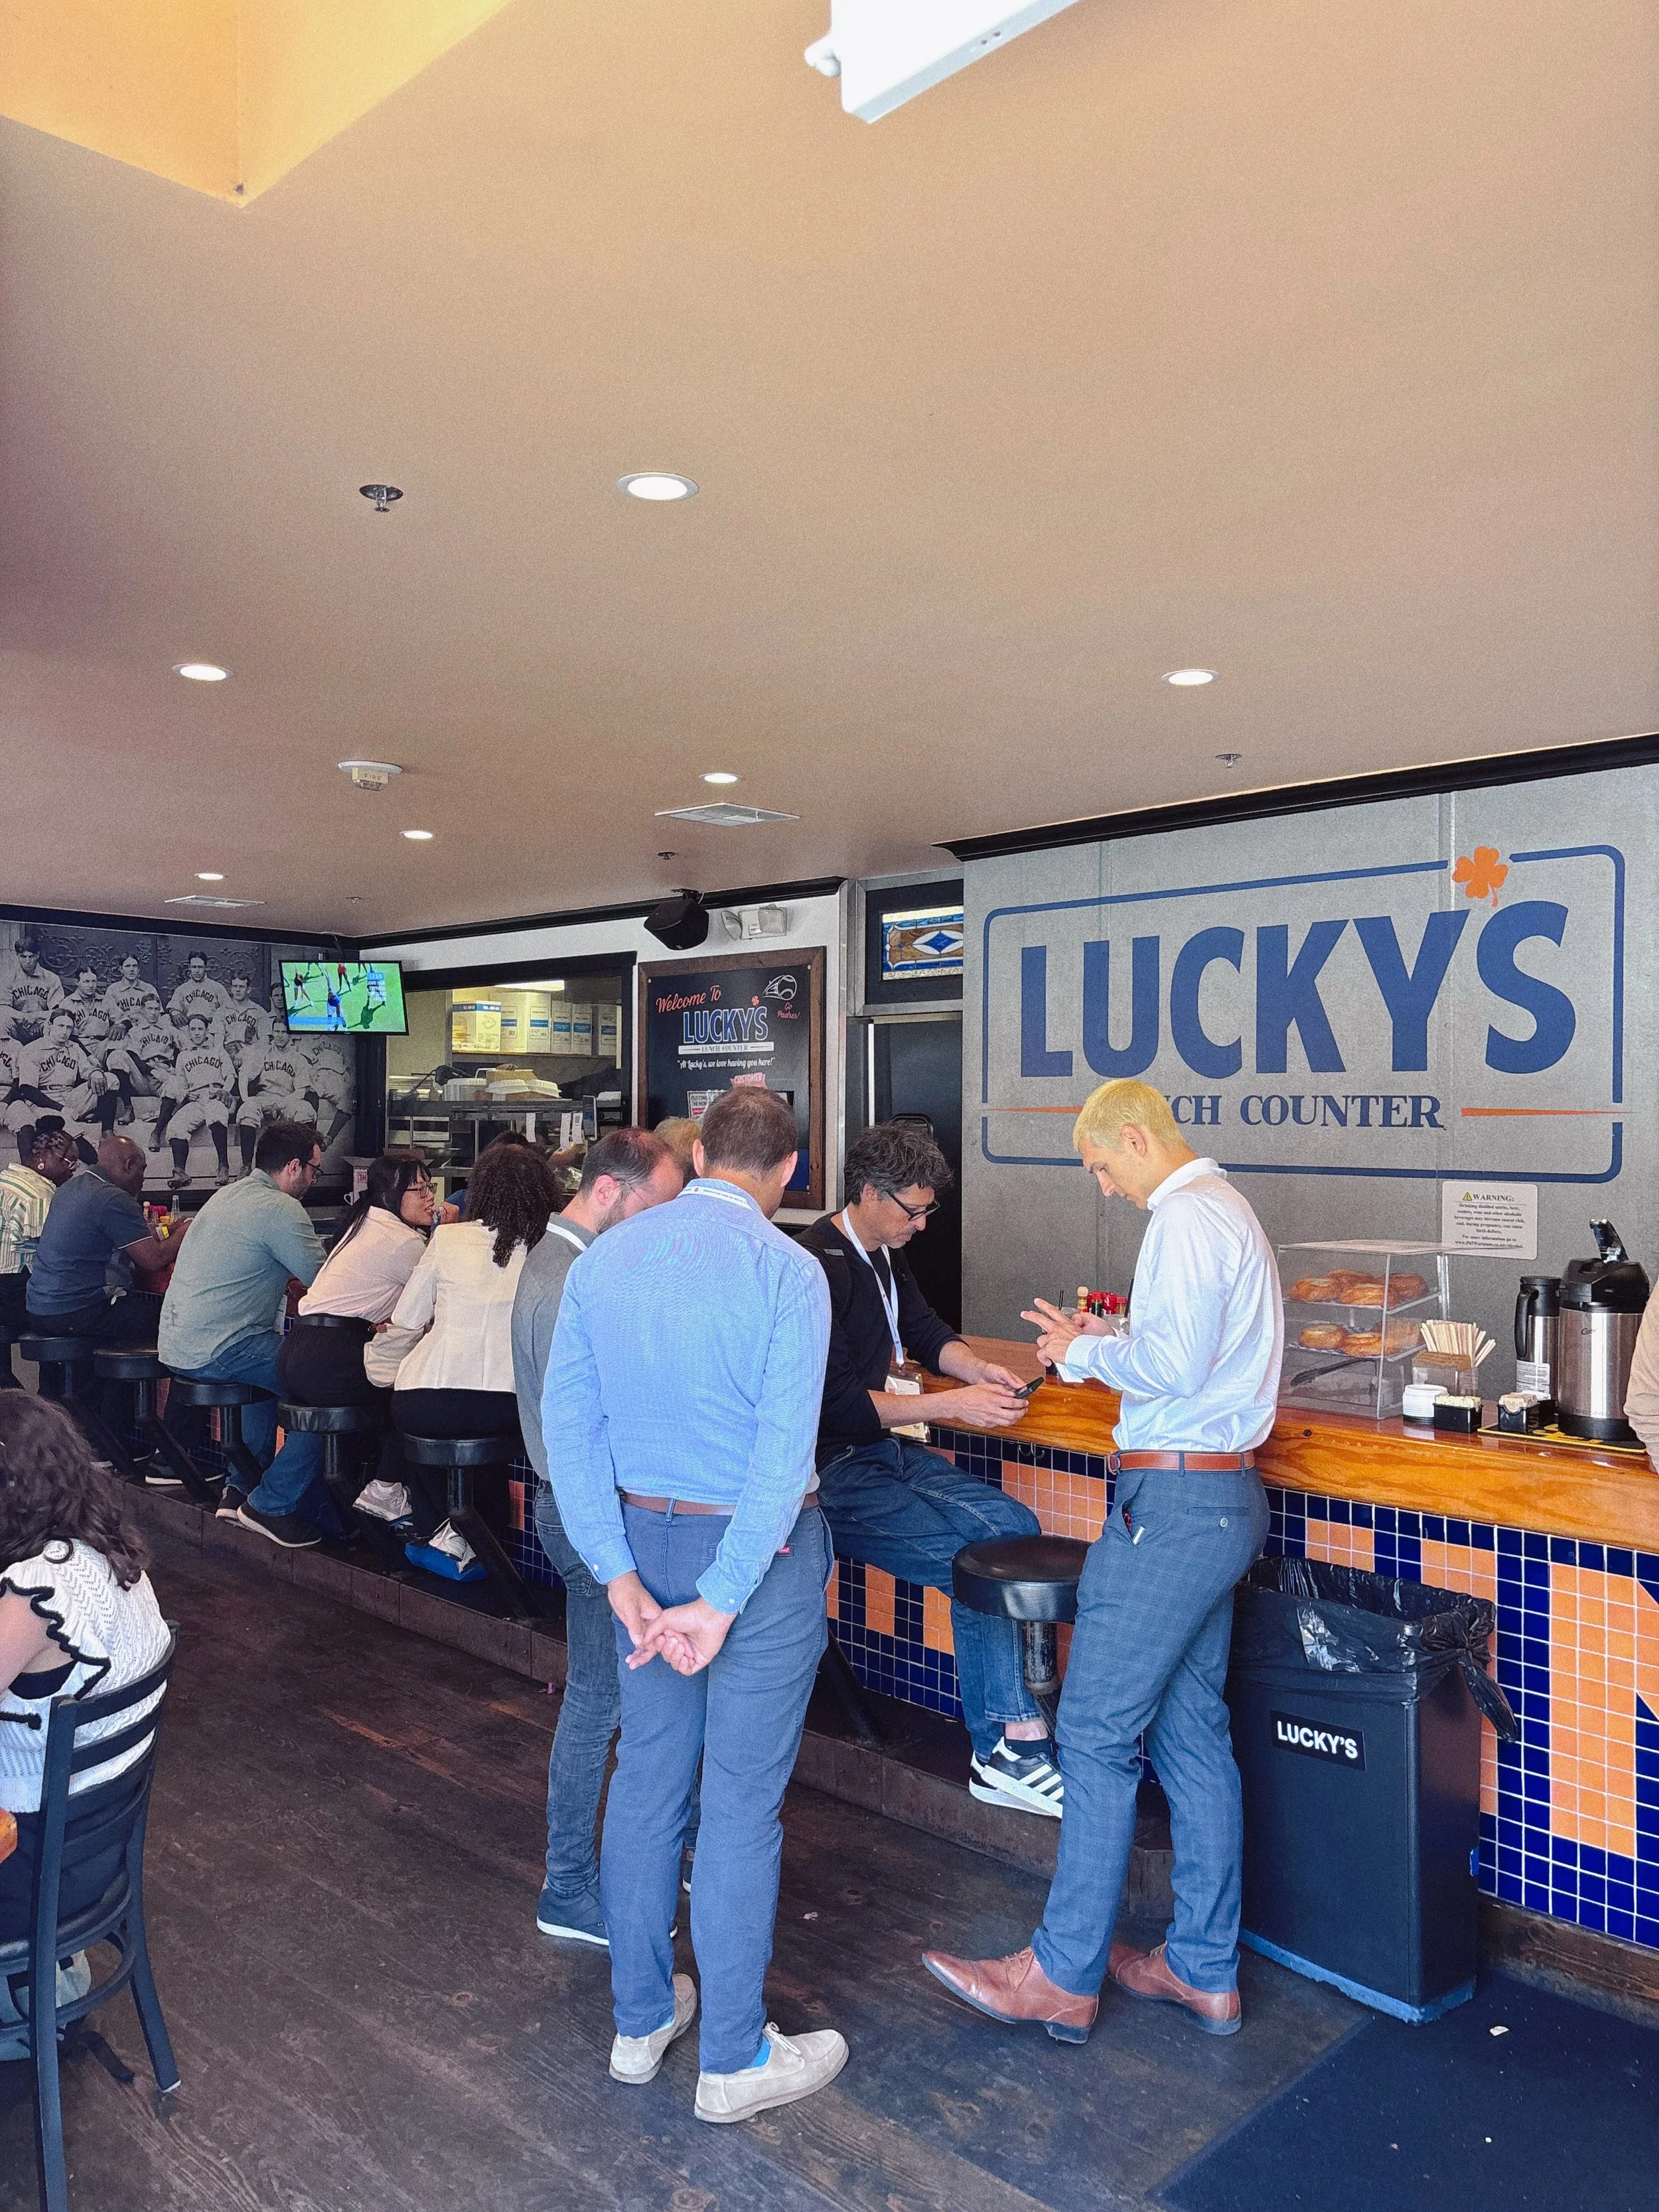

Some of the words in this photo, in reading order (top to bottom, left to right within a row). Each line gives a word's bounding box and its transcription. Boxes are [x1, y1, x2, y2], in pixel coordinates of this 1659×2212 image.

[13, 985, 50, 1000] CHICAGO
[185, 989, 214, 1004] CHICAGO
[656, 992, 707, 1013] Welcome
[710, 985, 722, 1001] To
[784, 1001, 792, 1011] Go
[225, 1013, 257, 1027] CHICAGO
[776, 1010, 801, 1019] Padres!
[39, 1051, 76, 1072] CHICAGO
[184, 1056, 221, 1072] CHICAGO
[717, 1059, 727, 1068] love
[727, 1059, 747, 1069] having
[747, 1060, 757, 1069] you
[734, 1072, 762, 1084] CUSTOMER
[1240, 1094, 1445, 1128] COUNTER
[1473, 1193, 1514, 1202] WARNING:
[1277, 1720, 1358, 1759] LUCKY'S
